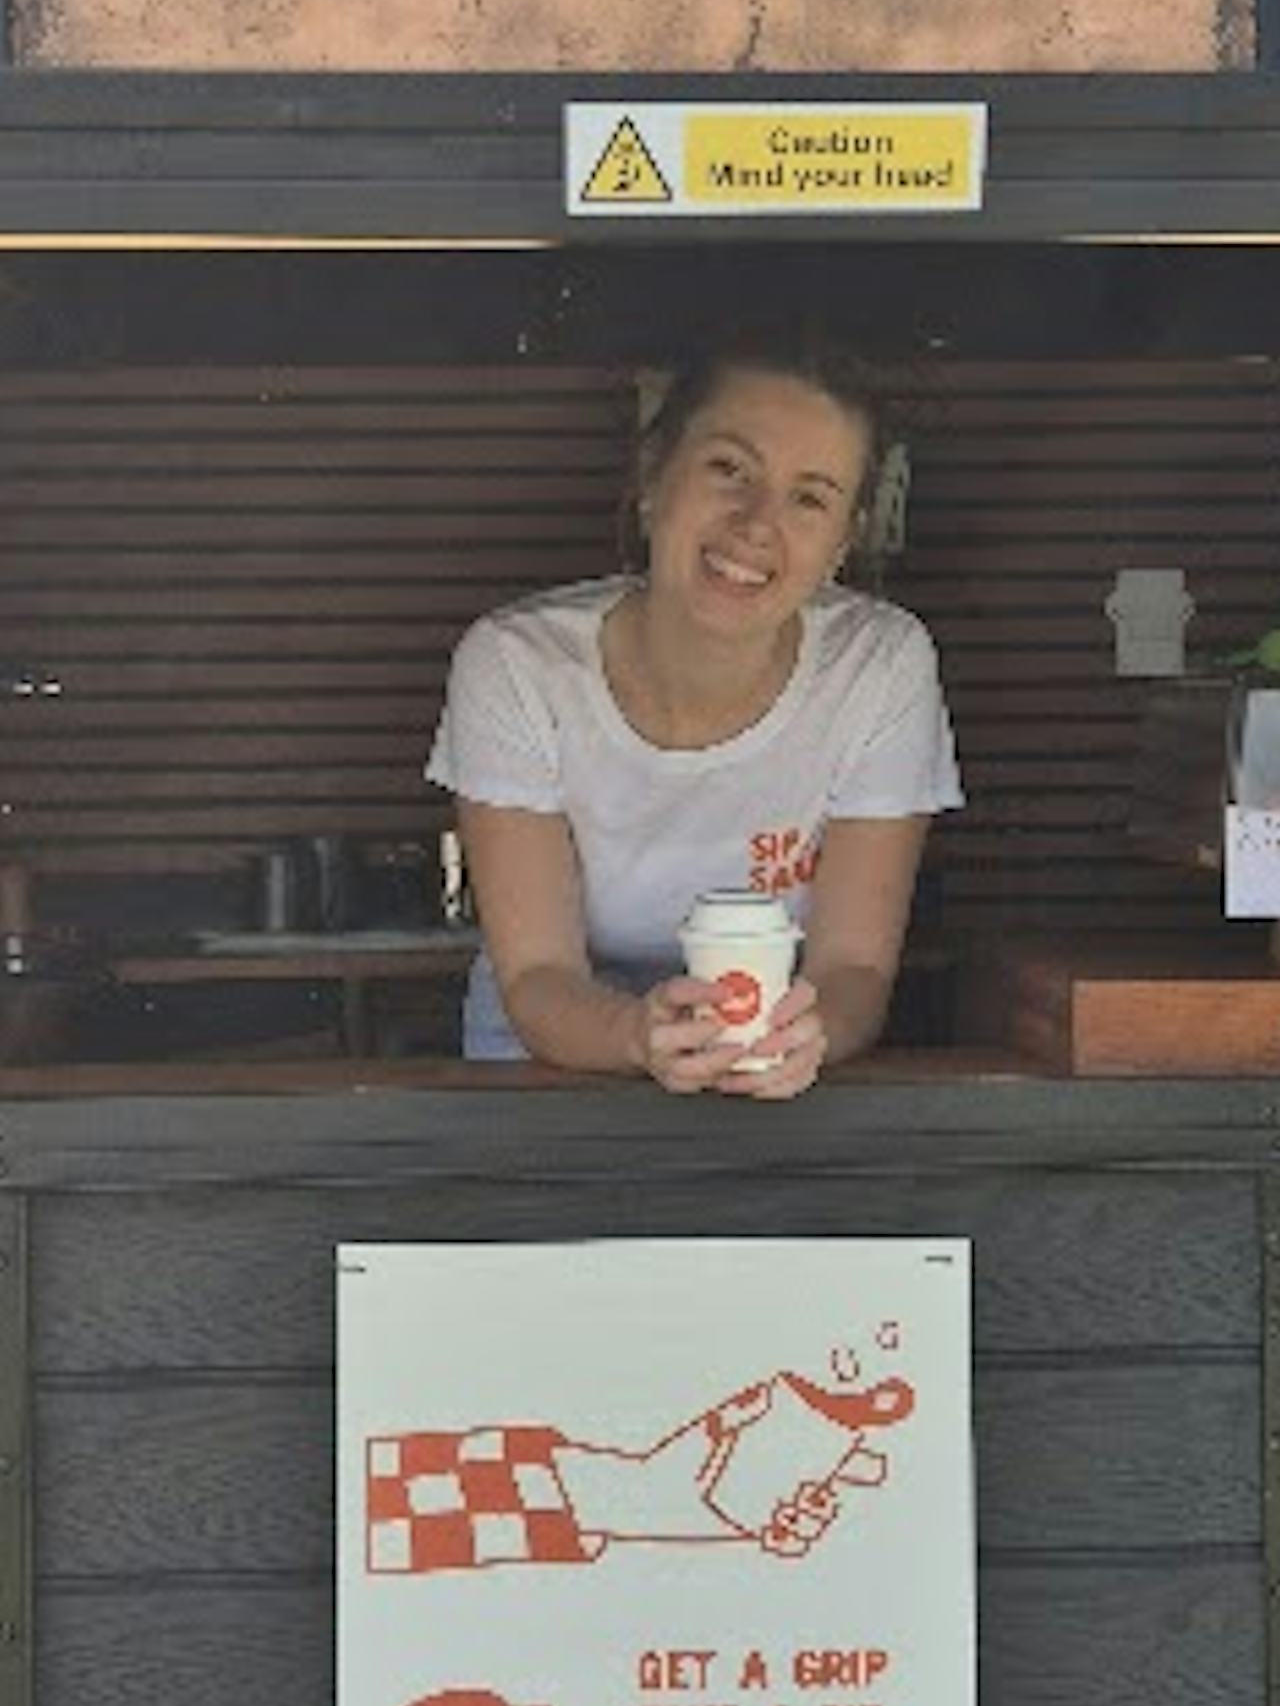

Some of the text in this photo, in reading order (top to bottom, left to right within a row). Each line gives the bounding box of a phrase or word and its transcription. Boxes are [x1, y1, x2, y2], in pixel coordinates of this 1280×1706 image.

[768, 127, 894, 154] Caution
[708, 162, 953, 191] Mind your head
[639, 1651, 888, 1691] GET A GRIP
